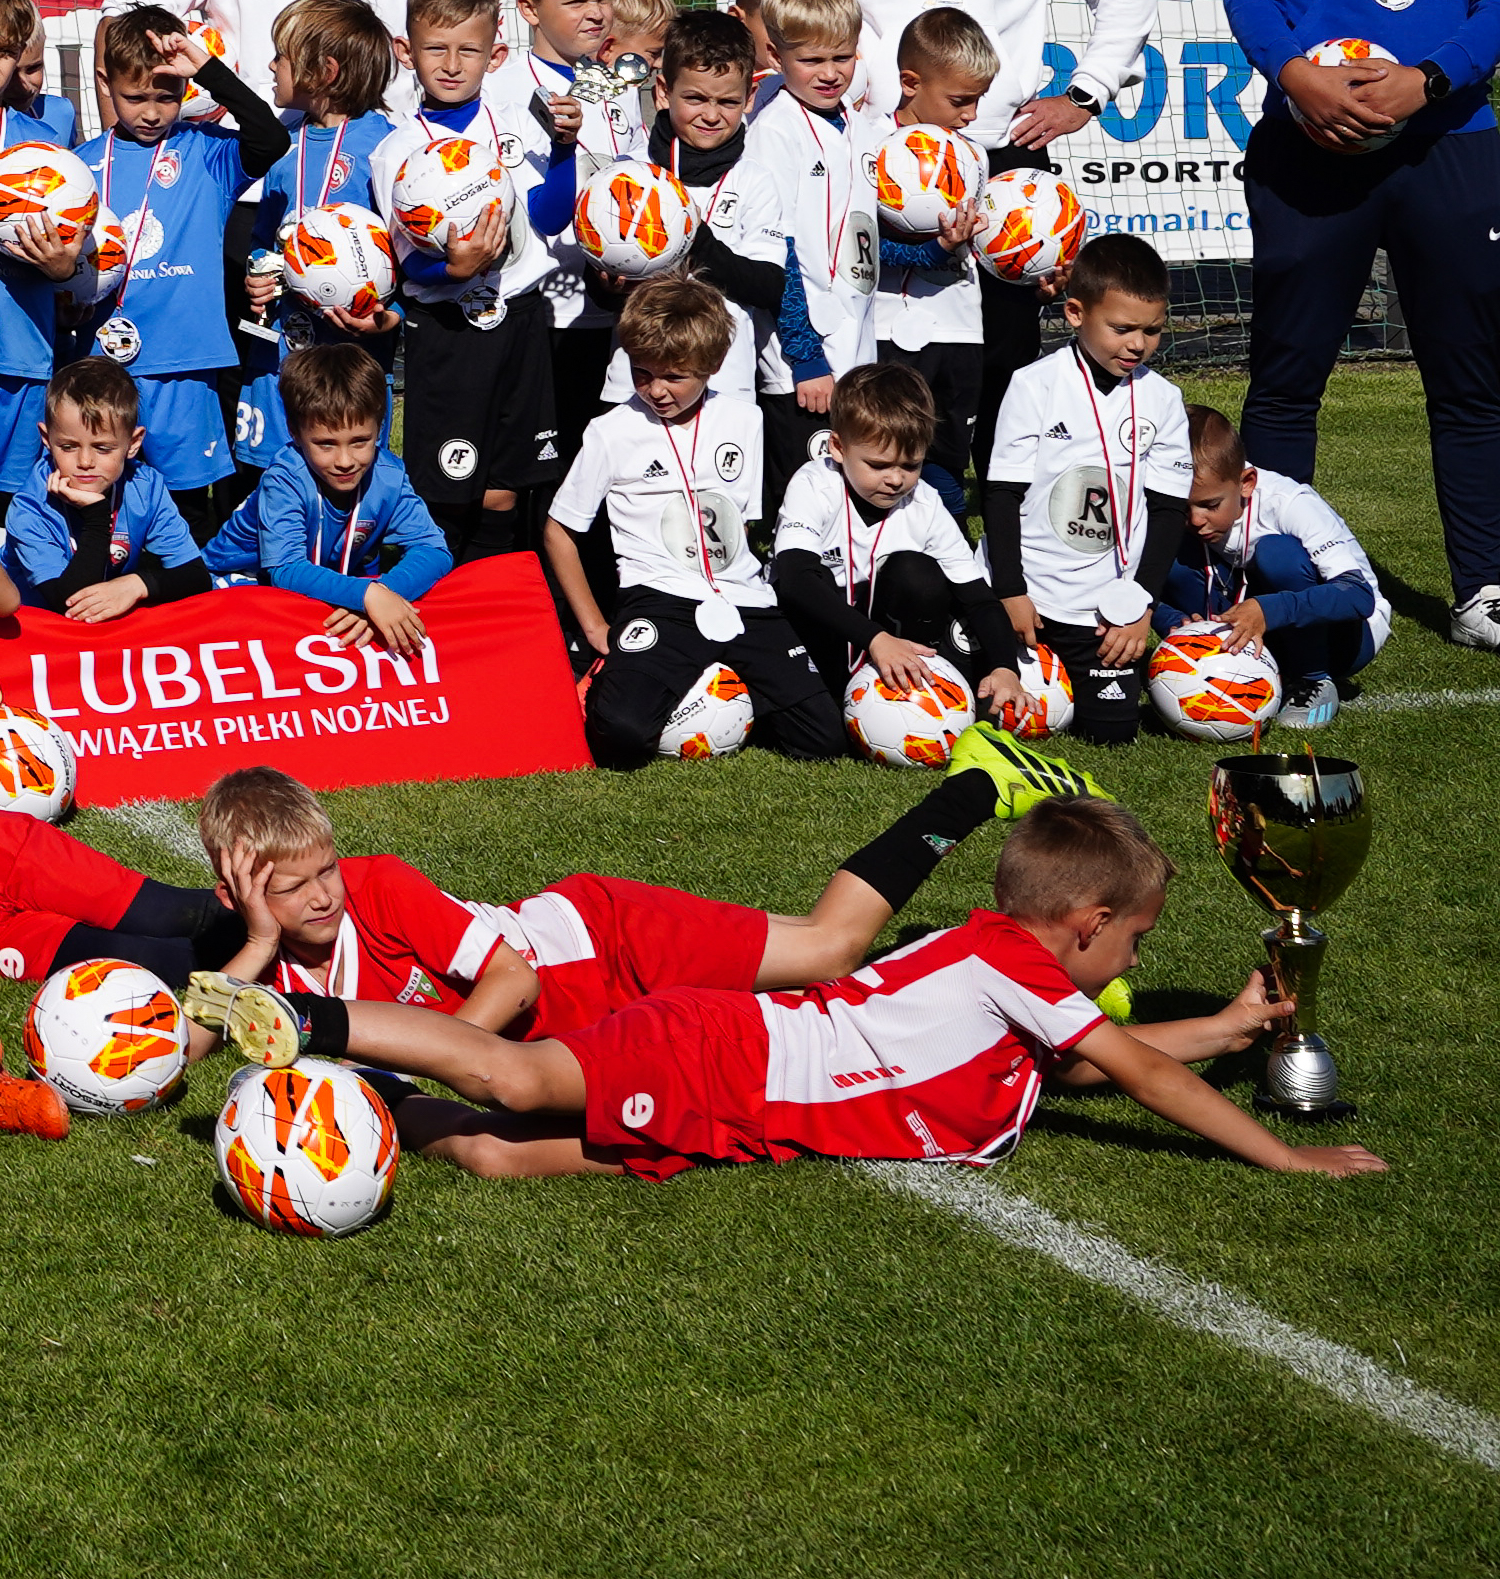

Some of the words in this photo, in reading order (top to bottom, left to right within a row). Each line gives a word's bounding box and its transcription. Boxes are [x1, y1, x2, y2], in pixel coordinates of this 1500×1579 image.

[446, 179, 491, 213] RESORT
[349, 226, 370, 280] RESORT
[855, 230, 874, 265] R
[159, 261, 195, 277] SOWA
[1078, 485, 1108, 524] R
[1067, 520, 1112, 541] Steel
[68, 719, 208, 761] WIĄZEK
[215, 709, 305, 745] PIŁKI
[310, 695, 451, 736] NOŻNEJ
[49, 1074, 117, 1114] RESORT
